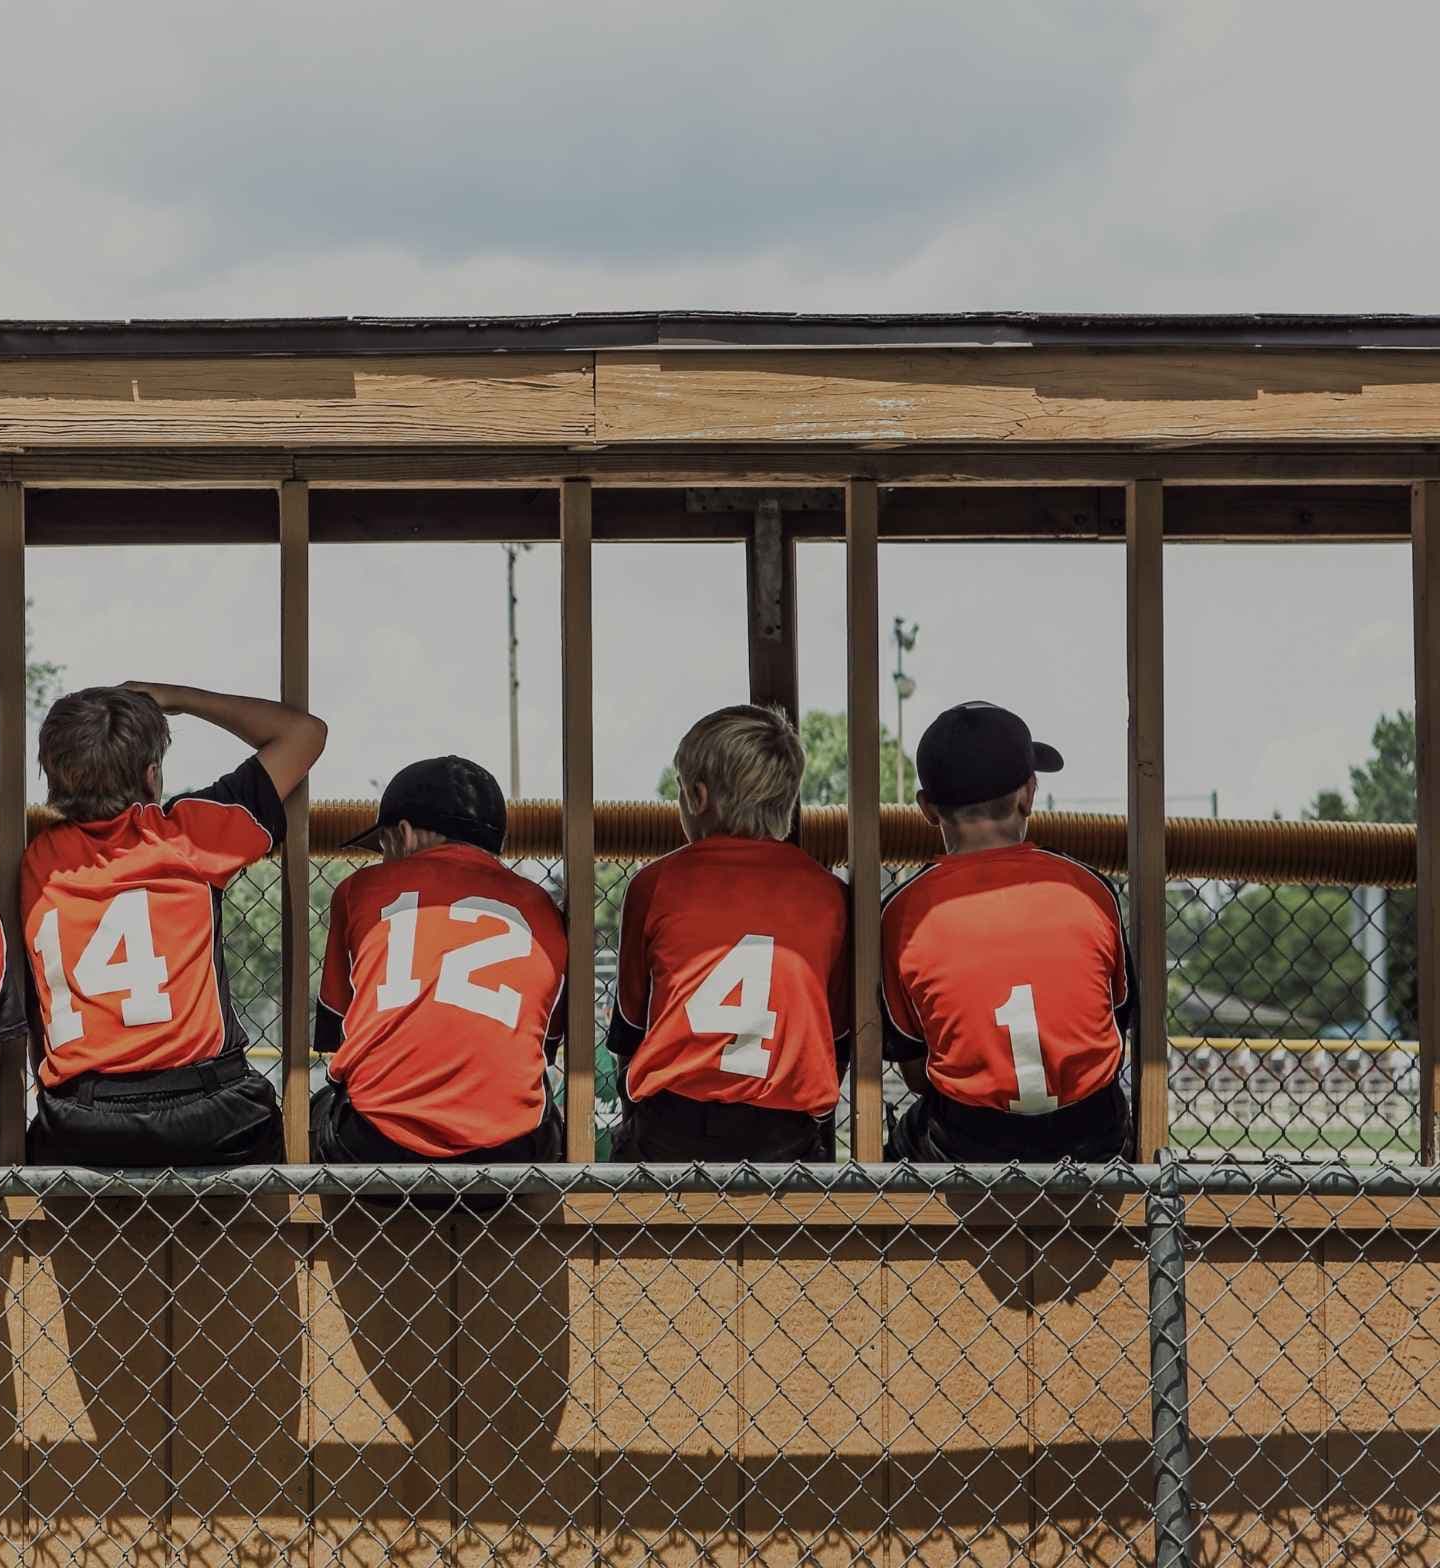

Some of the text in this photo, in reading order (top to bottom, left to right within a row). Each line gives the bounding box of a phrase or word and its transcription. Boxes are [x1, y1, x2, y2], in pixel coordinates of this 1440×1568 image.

[33, 887, 173, 1051] 14
[375, 890, 535, 1030] 12
[684, 933, 777, 1079] 4
[994, 983, 1059, 1115] 1
